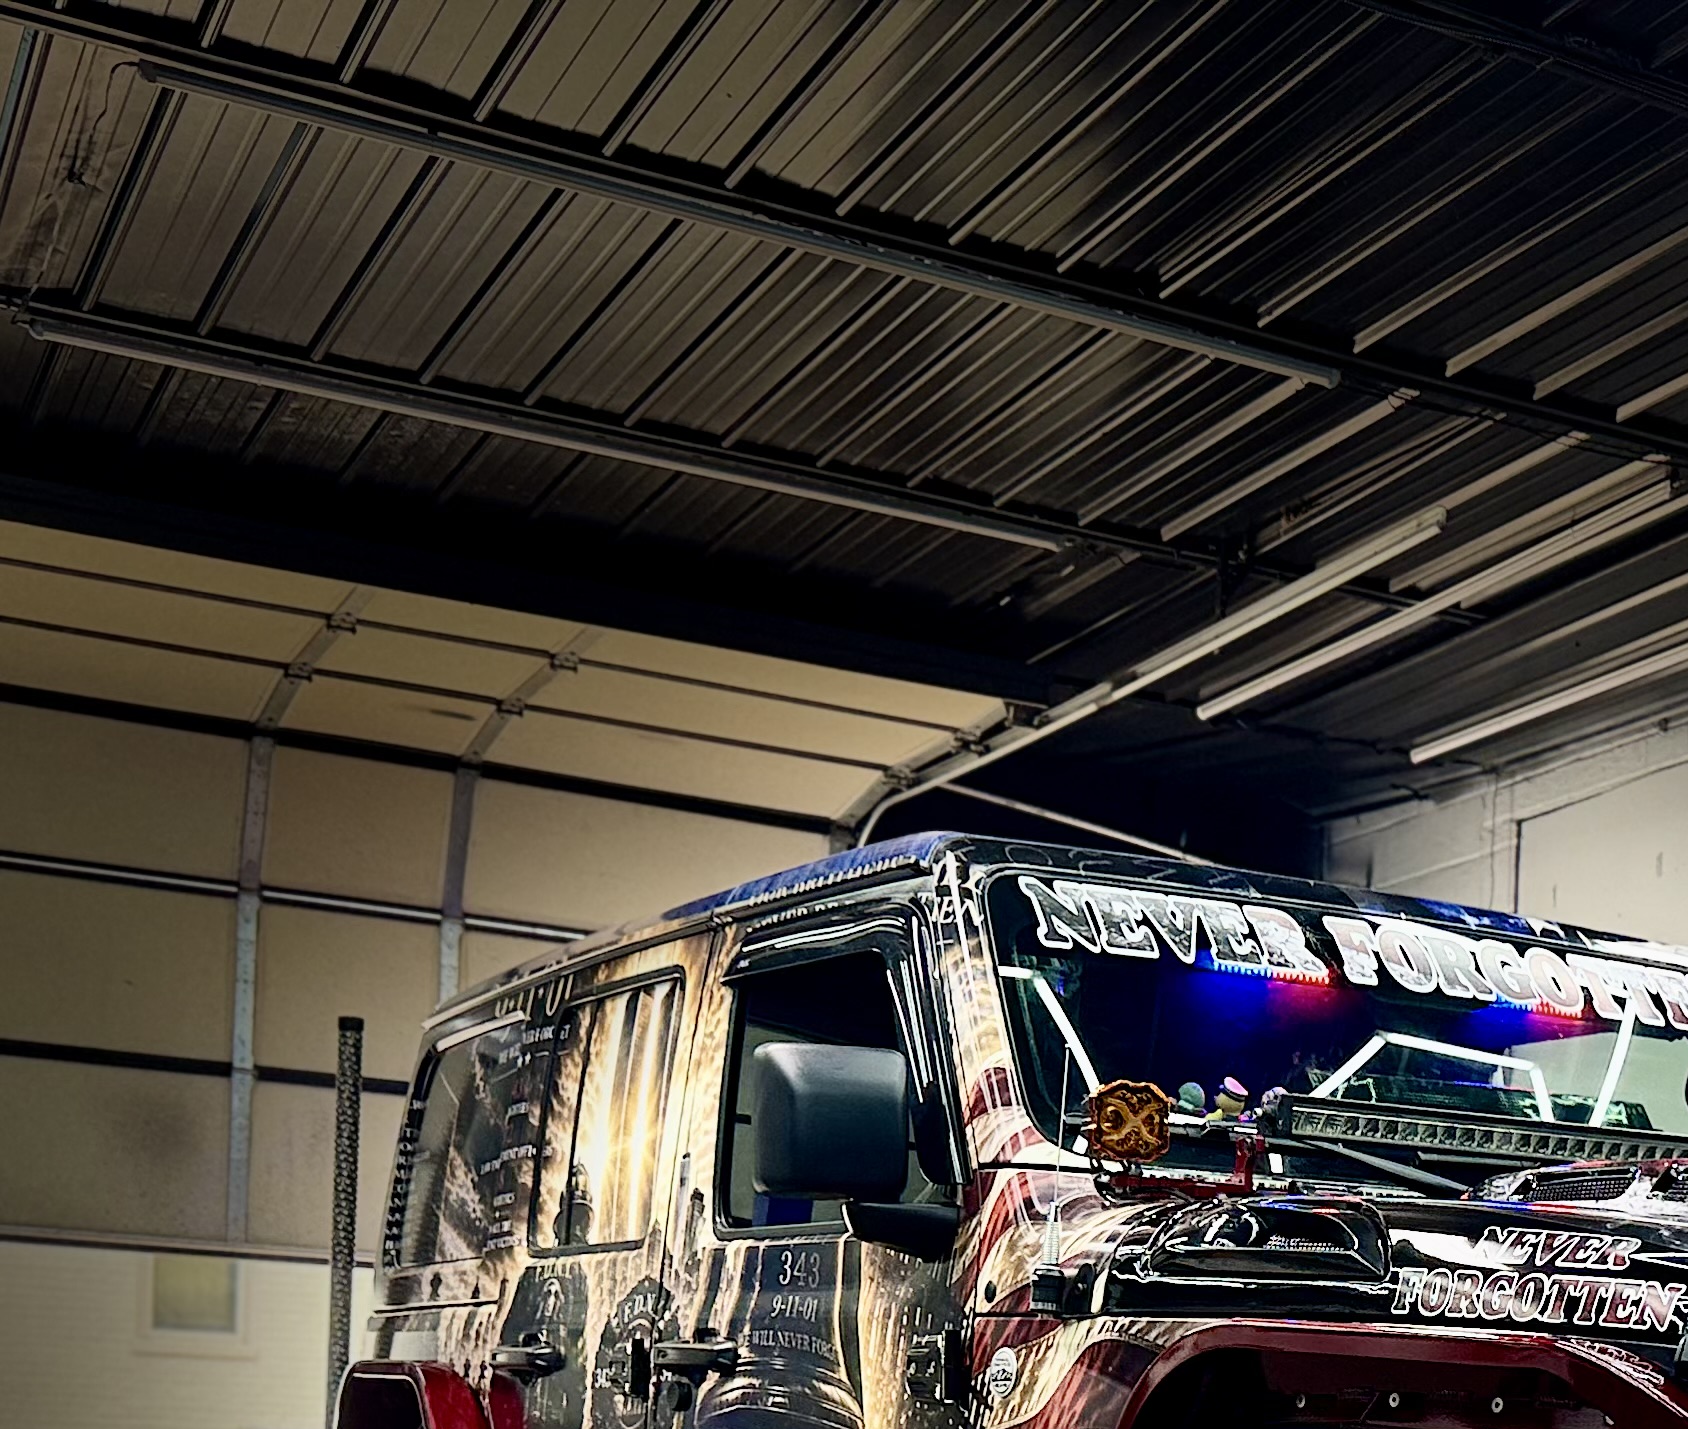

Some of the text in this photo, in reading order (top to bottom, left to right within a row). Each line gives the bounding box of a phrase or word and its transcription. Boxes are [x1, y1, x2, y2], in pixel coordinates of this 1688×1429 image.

[1017, 874, 1330, 978] NEVER
[1481, 1225, 1642, 1270] NEVER
[778, 1250, 820, 1289] 343
[770, 1294, 818, 1323] 9-11-01
[1391, 1267, 1687, 1333] FORGOTTEN
[751, 1329, 775, 1347] WILL
[777, 1330, 810, 1352] NEVER
